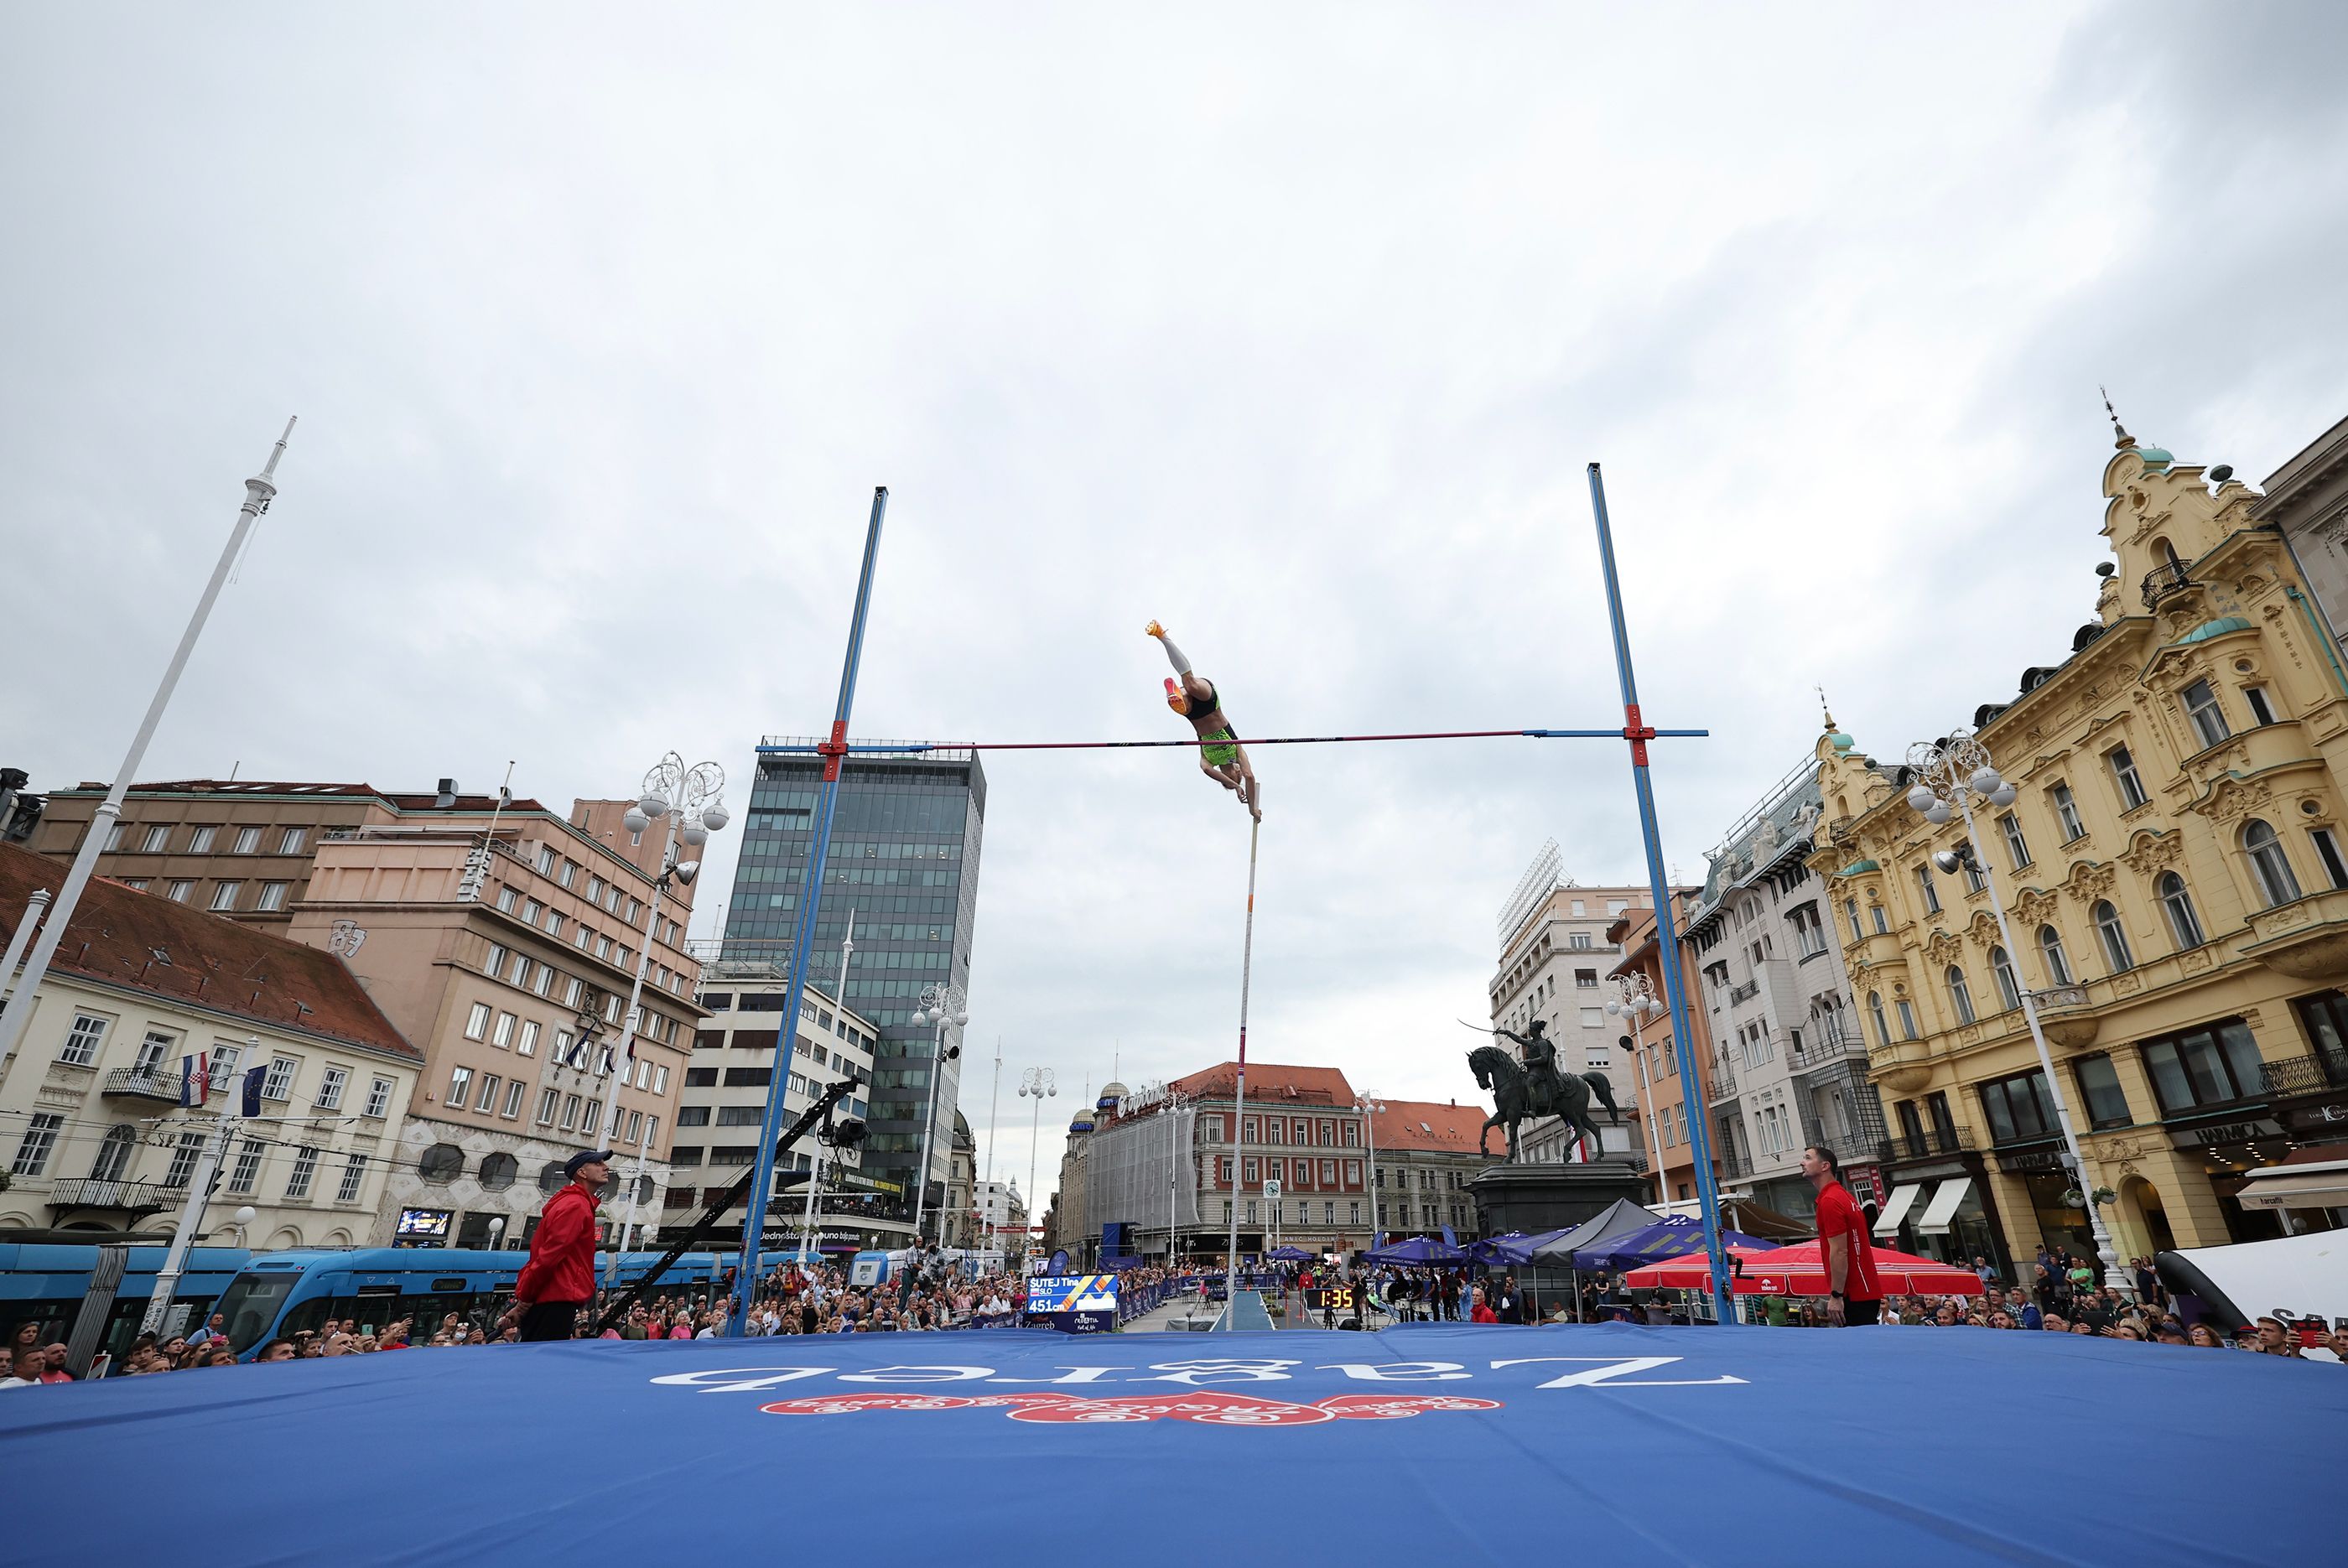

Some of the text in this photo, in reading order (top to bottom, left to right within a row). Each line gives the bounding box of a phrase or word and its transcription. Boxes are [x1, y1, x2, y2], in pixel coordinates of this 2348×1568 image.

[2195, 1123, 2267, 1143] HARMICA
[1030, 1277, 1079, 1288] ŠUTEJ Tina
[1321, 1289, 1353, 1308] 1:35
[1025, 1321, 1055, 1330] Zagreb
[650, 1358, 1750, 1392] Zagreb
[1056, 1402, 1301, 1414] ZAGREB
